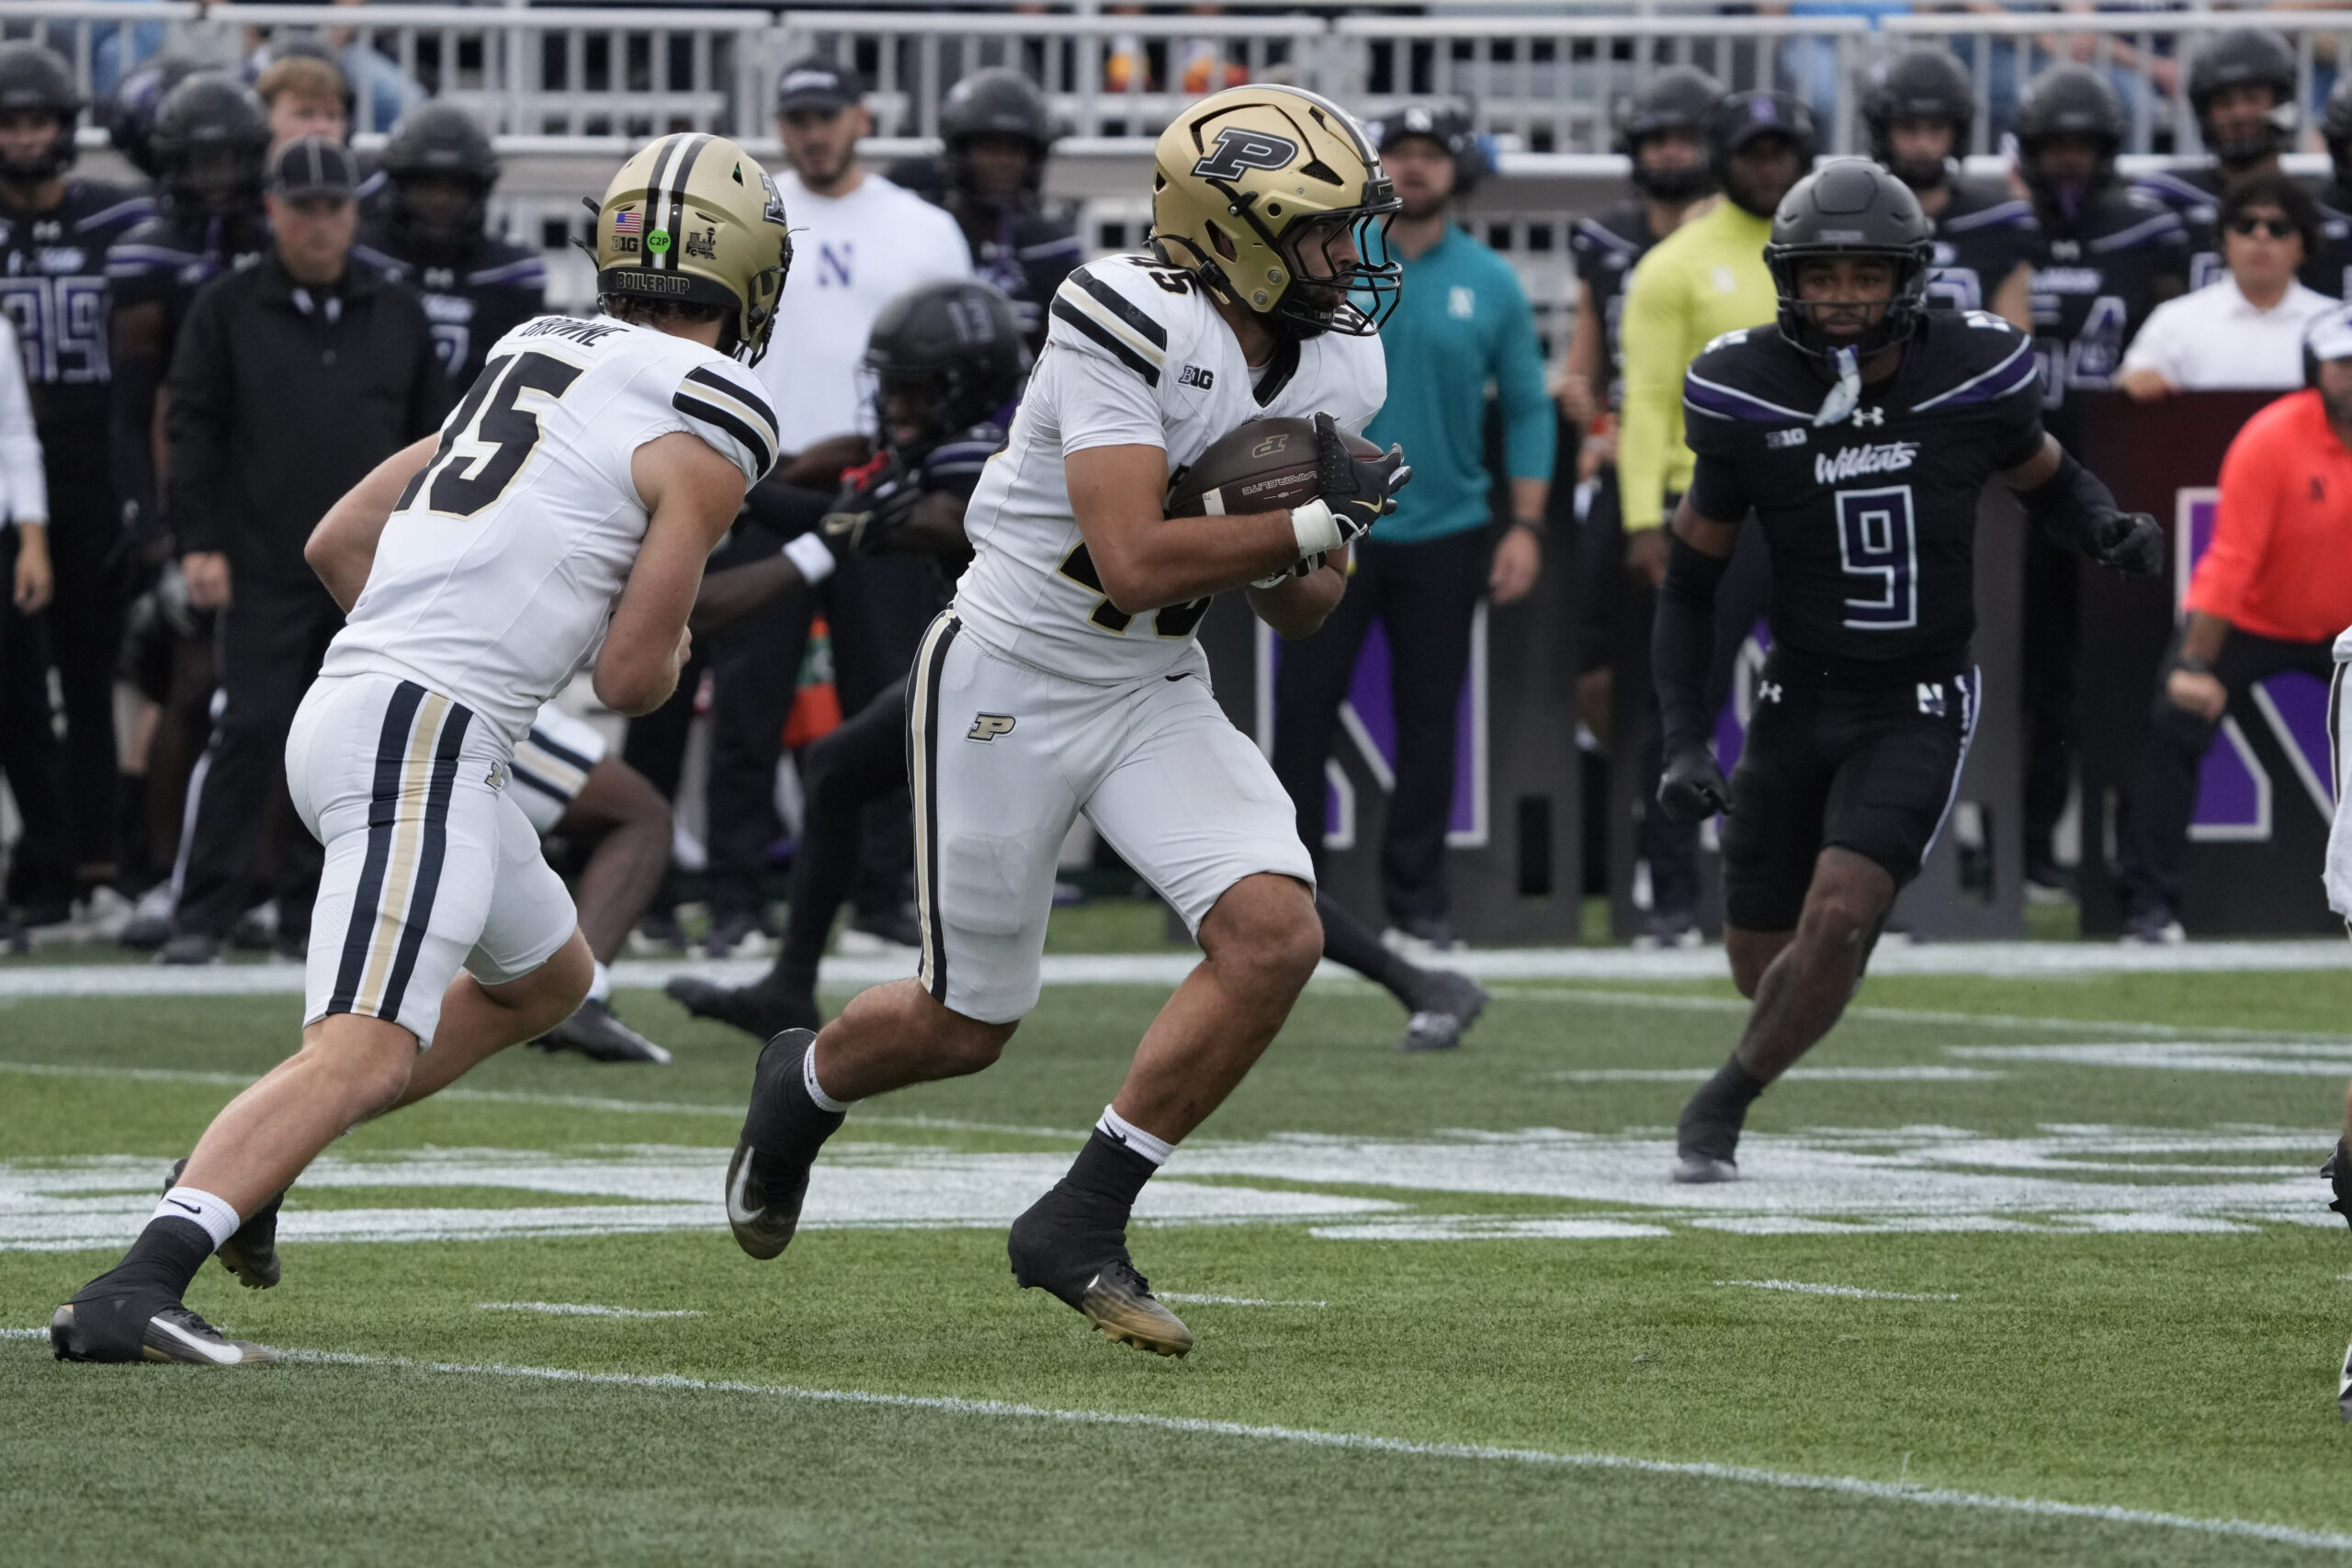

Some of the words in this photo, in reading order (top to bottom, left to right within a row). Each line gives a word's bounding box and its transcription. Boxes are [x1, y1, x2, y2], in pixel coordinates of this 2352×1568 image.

[1191, 127, 1299, 183] P
[649, 236, 670, 247] C2P
[819, 243, 853, 287] N
[616, 271, 667, 293] BOILER
[668, 276, 689, 295] UP
[517, 317, 632, 348] BROWNE
[1178, 364, 1215, 391] BIG
[391, 349, 592, 523] 15
[1251, 433, 1290, 459] P
[1814, 440, 1922, 485] Wildcats
[1835, 483, 1918, 630] 9
[965, 710, 1017, 744] P
